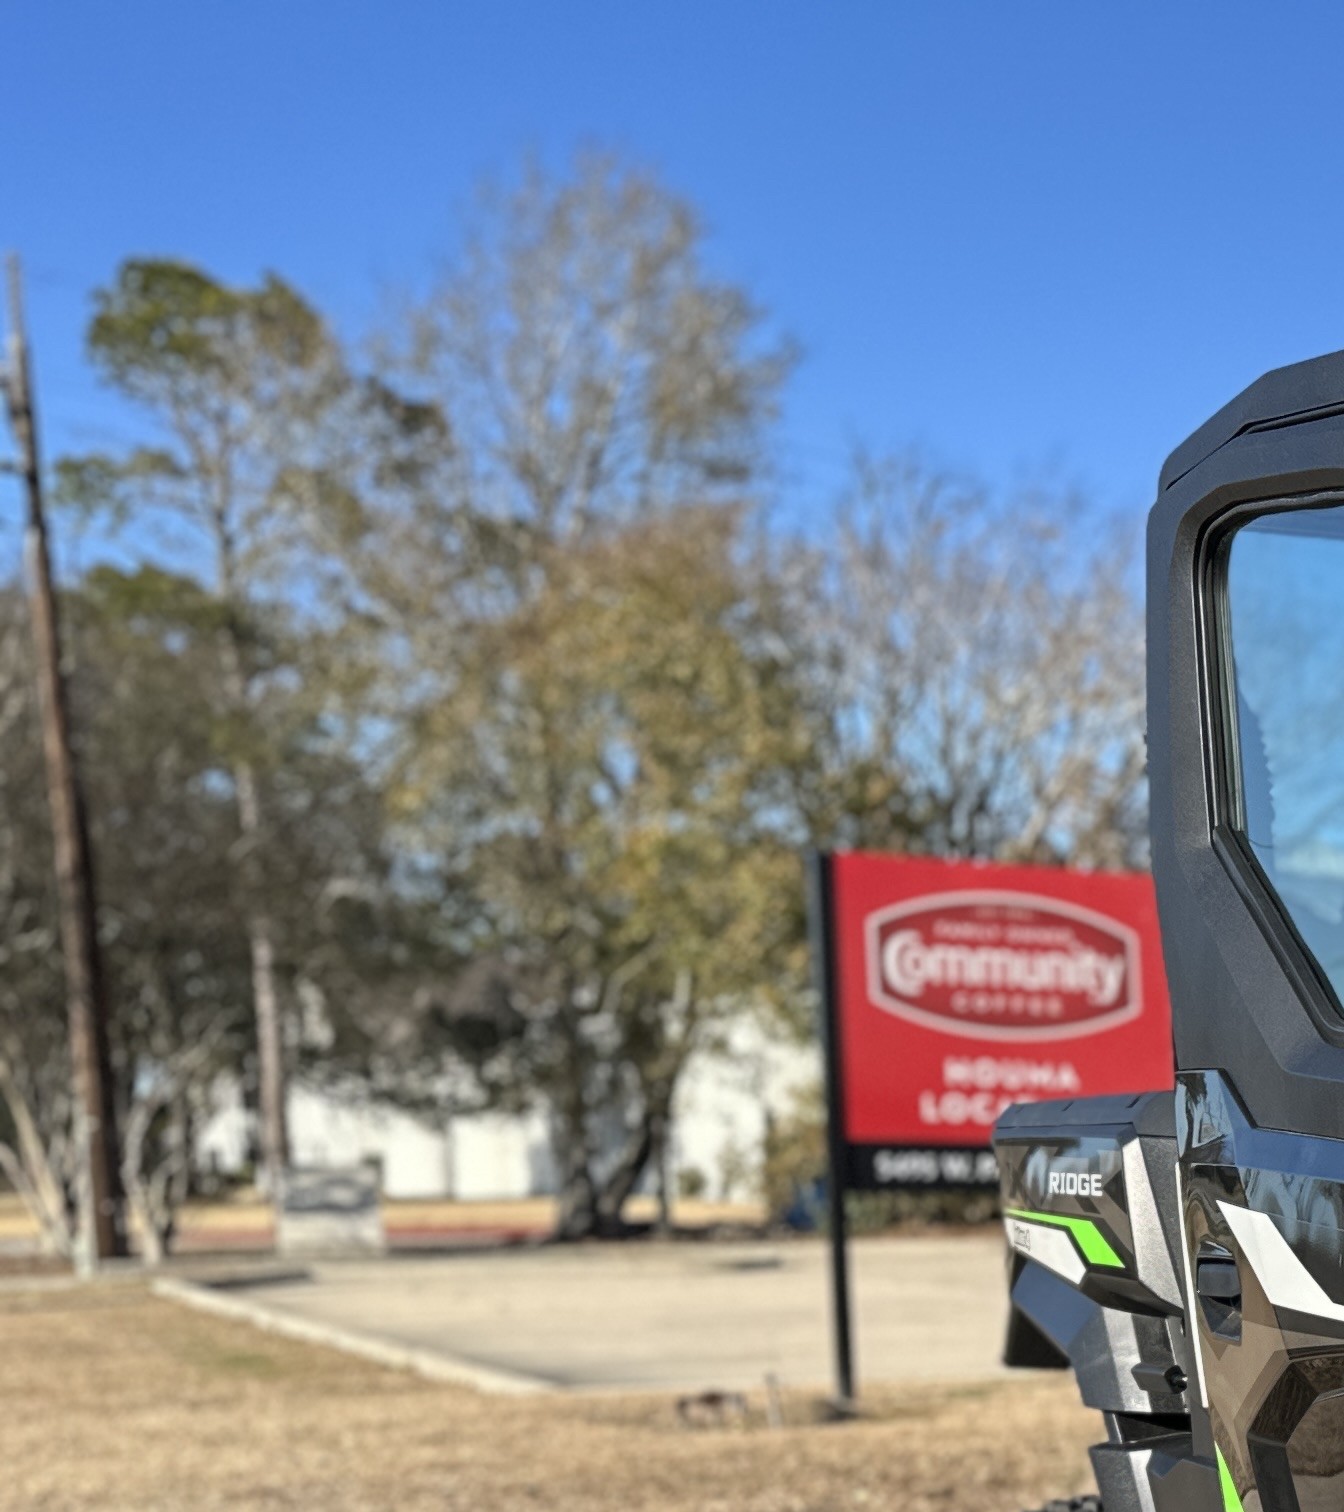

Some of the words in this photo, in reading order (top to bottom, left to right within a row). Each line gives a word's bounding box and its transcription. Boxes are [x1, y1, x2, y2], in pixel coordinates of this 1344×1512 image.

[883, 929, 1125, 1006] Community
[942, 1055, 1081, 1092] HOUMA
[1048, 1171, 1103, 1197] RIDGE
